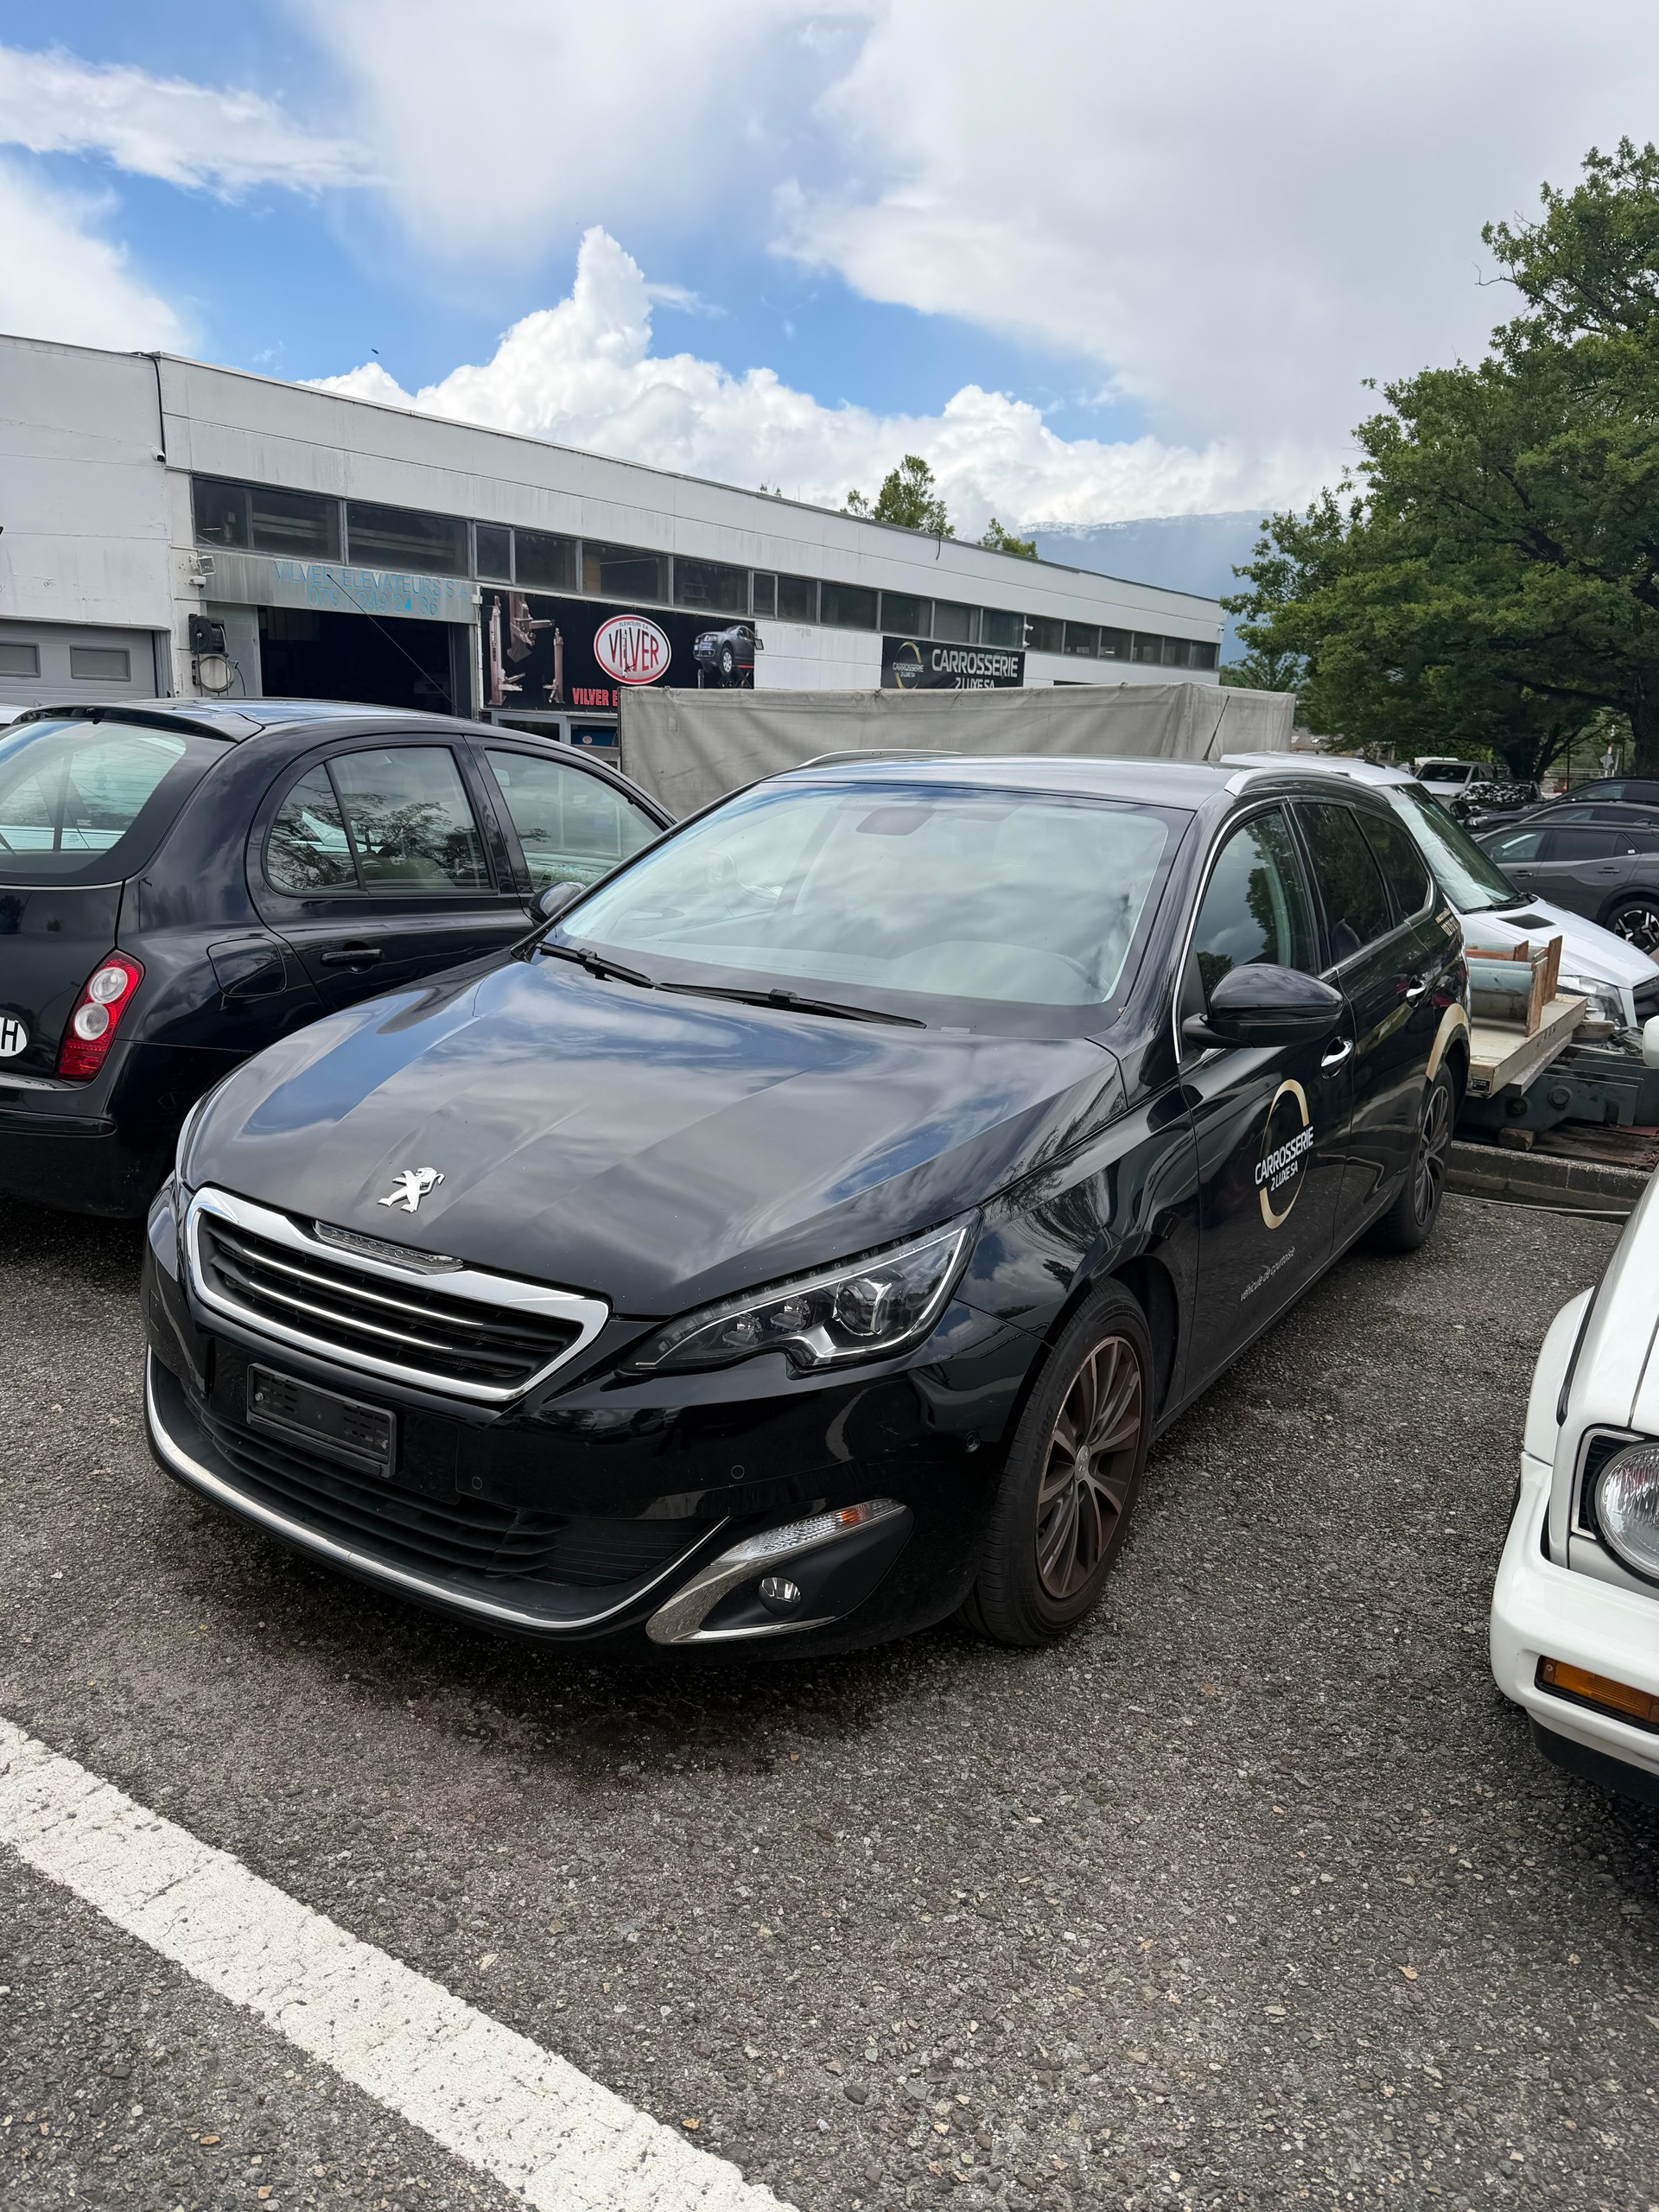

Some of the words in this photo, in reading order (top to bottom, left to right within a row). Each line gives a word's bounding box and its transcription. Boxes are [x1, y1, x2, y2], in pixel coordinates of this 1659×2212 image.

[273, 562, 334, 586] VILVER
[343, 568, 442, 596] ELEVATEURS
[308, 586, 340, 608] 079
[358, 592, 388, 613] 249
[418, 597, 437, 617] 36
[609, 627, 659, 672] VILVER
[931, 649, 1019, 677] CARROSSERIE
[893, 662, 924, 672] CARROSSERIE
[572, 688, 609, 706] VILVER
[1255, 1126, 1313, 1185] CARROSSERIE
